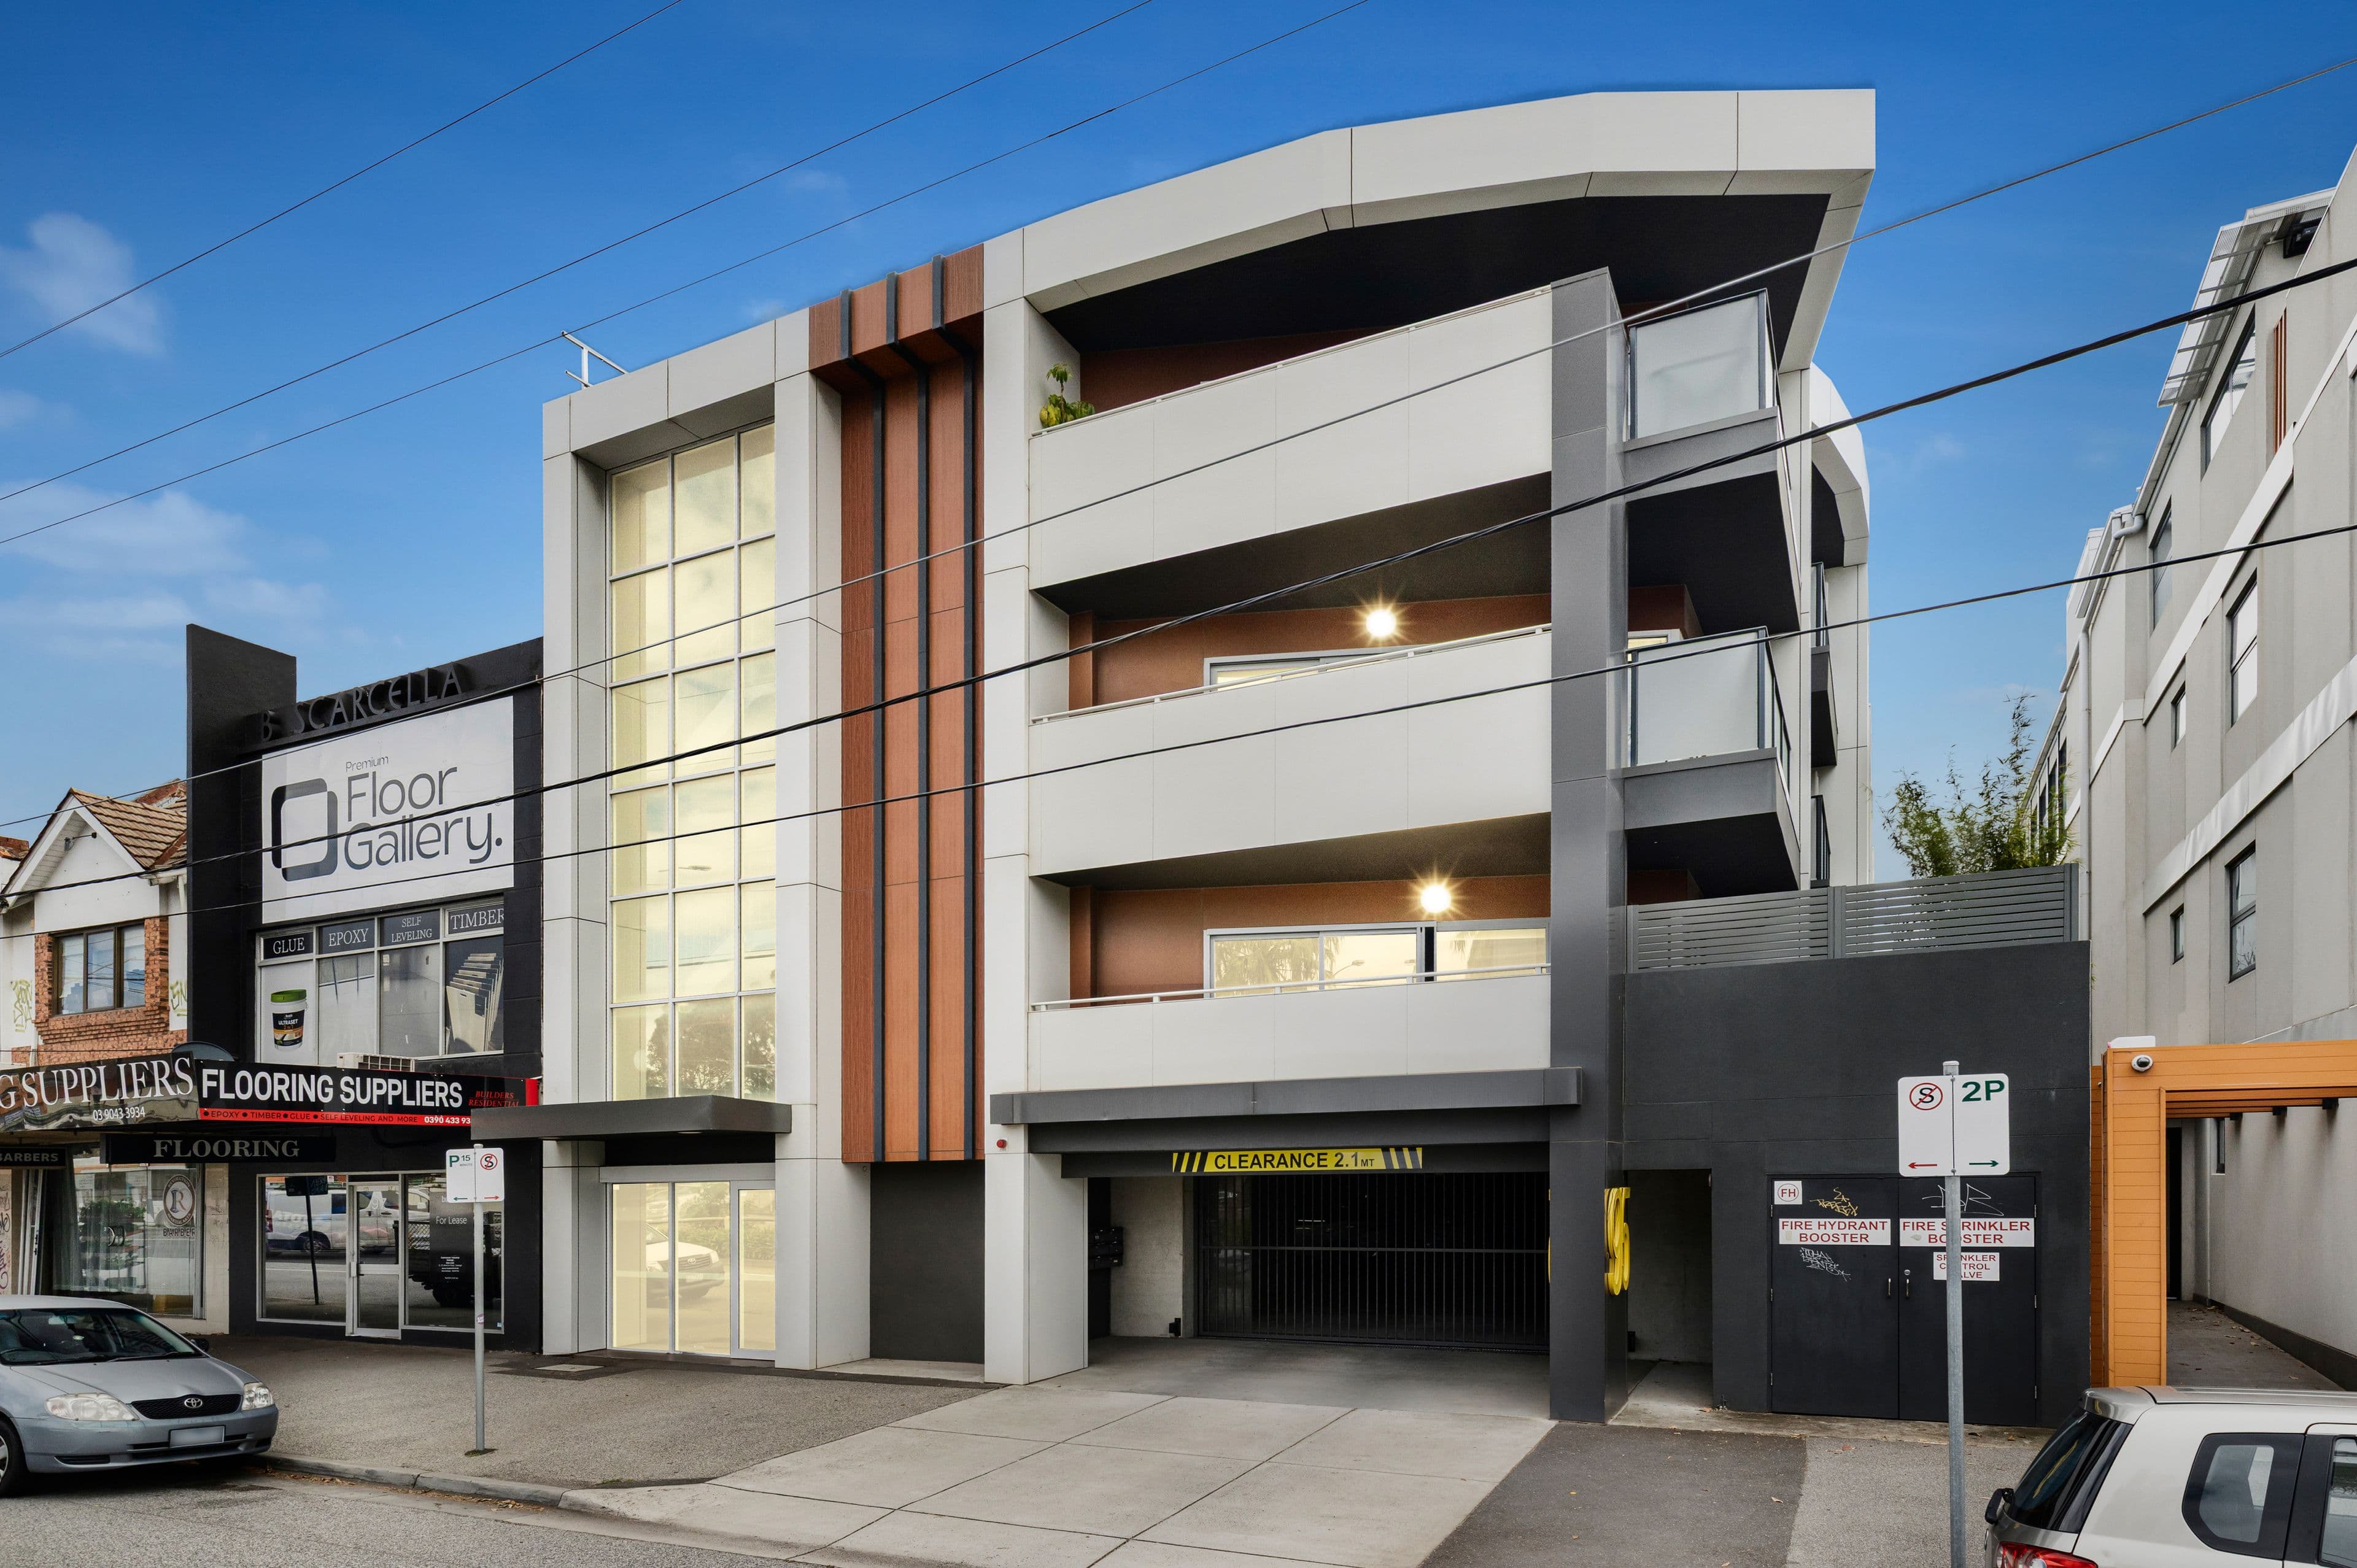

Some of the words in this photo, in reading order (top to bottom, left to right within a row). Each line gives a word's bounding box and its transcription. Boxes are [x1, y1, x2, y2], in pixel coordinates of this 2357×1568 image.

[292, 665, 462, 734] SCARCELLA
[346, 756, 389, 772] Premium
[347, 767, 457, 822] Floor
[401, 916, 422, 928] SELF
[451, 908, 504, 930] TIMBER
[328, 928, 368, 947] EPOXY
[391, 929, 433, 943] LEVELING
[273, 938, 305, 954] GLUE
[21, 1057, 194, 1107] SUPPLIERS
[202, 1068, 333, 1103] FLOORING
[339, 1076, 462, 1108] SUPPLIERS
[476, 1091, 514, 1099] BUILDERS
[1962, 1080, 2005, 1102] 2P
[93, 1110, 103, 1121] 03
[104, 1108, 124, 1121] 9043
[126, 1106, 145, 1119] 3934
[153, 1140, 300, 1157] FLOORING
[449, 1155, 460, 1167] P
[1213, 1153, 1328, 1170] CLEARANCE
[1781, 1188, 1796, 1197] FH
[449, 1216, 467, 1225] Lease
[1782, 1221, 1813, 1230] FIRE
[1817, 1221, 1887, 1230] HYDRANT
[1902, 1221, 1935, 1231] FIRE
[1941, 1221, 2030, 1231] SRINKLER
[1799, 1234, 1870, 1243] BOOSTER
[1928, 1234, 2004, 1243] BOSTER
